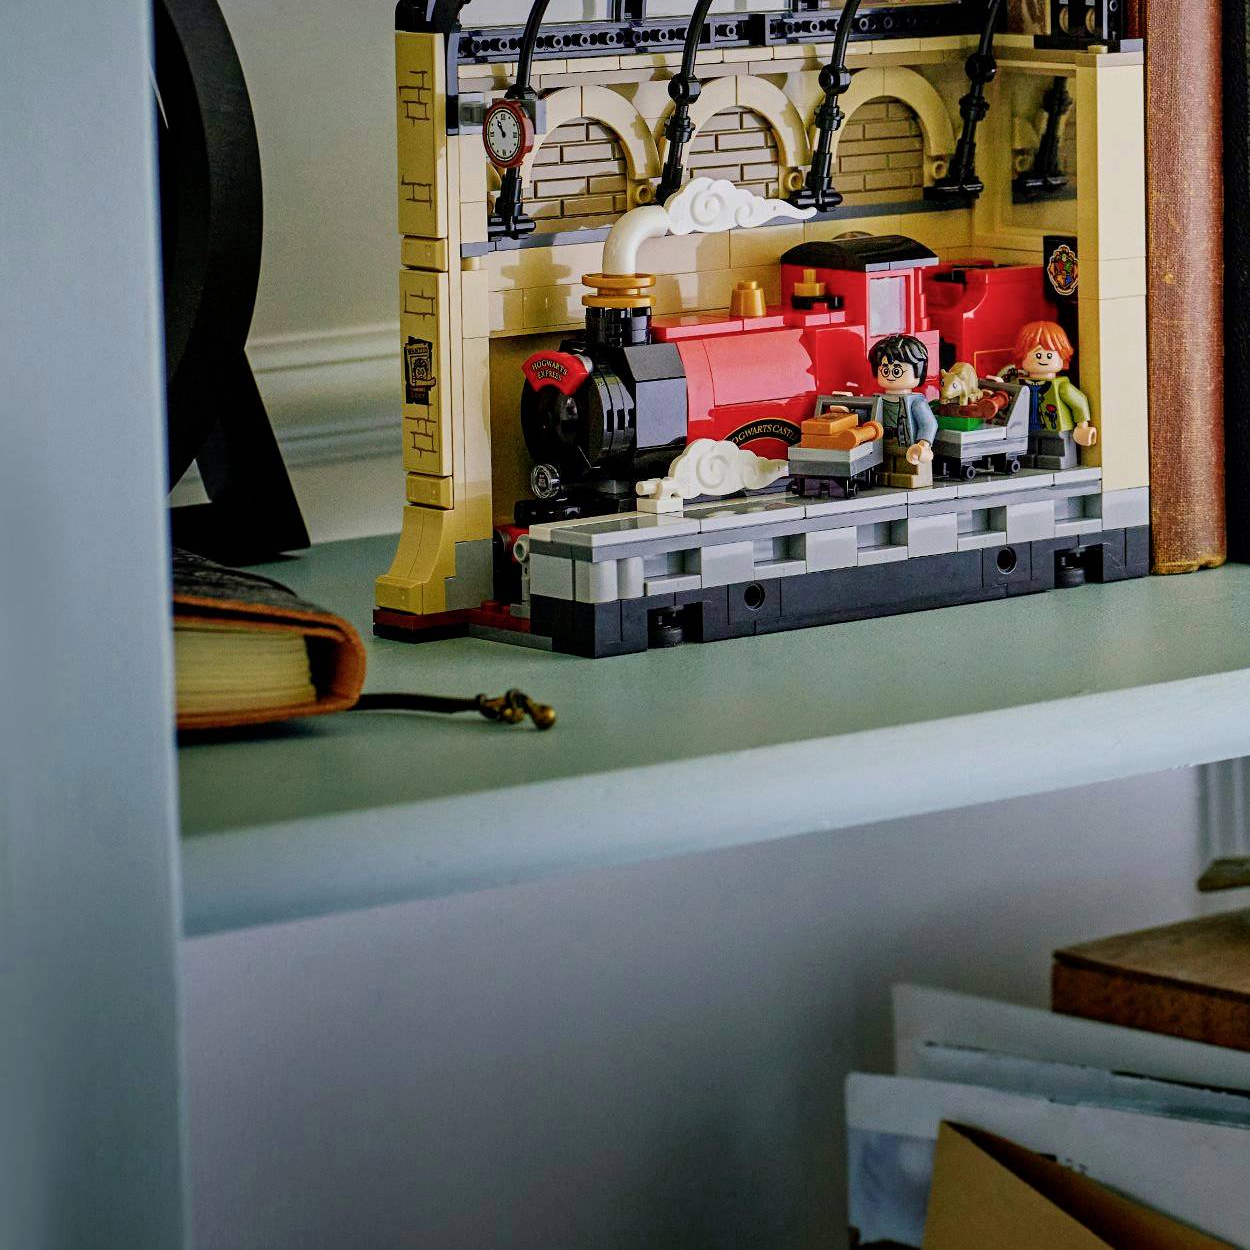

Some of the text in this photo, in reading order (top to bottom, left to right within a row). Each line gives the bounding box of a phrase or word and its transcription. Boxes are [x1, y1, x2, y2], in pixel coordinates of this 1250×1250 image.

[531, 359, 568, 376] HOGWARTS
[537, 369, 562, 382] EXPRESS
[731, 424, 772, 444] OGWARTS
